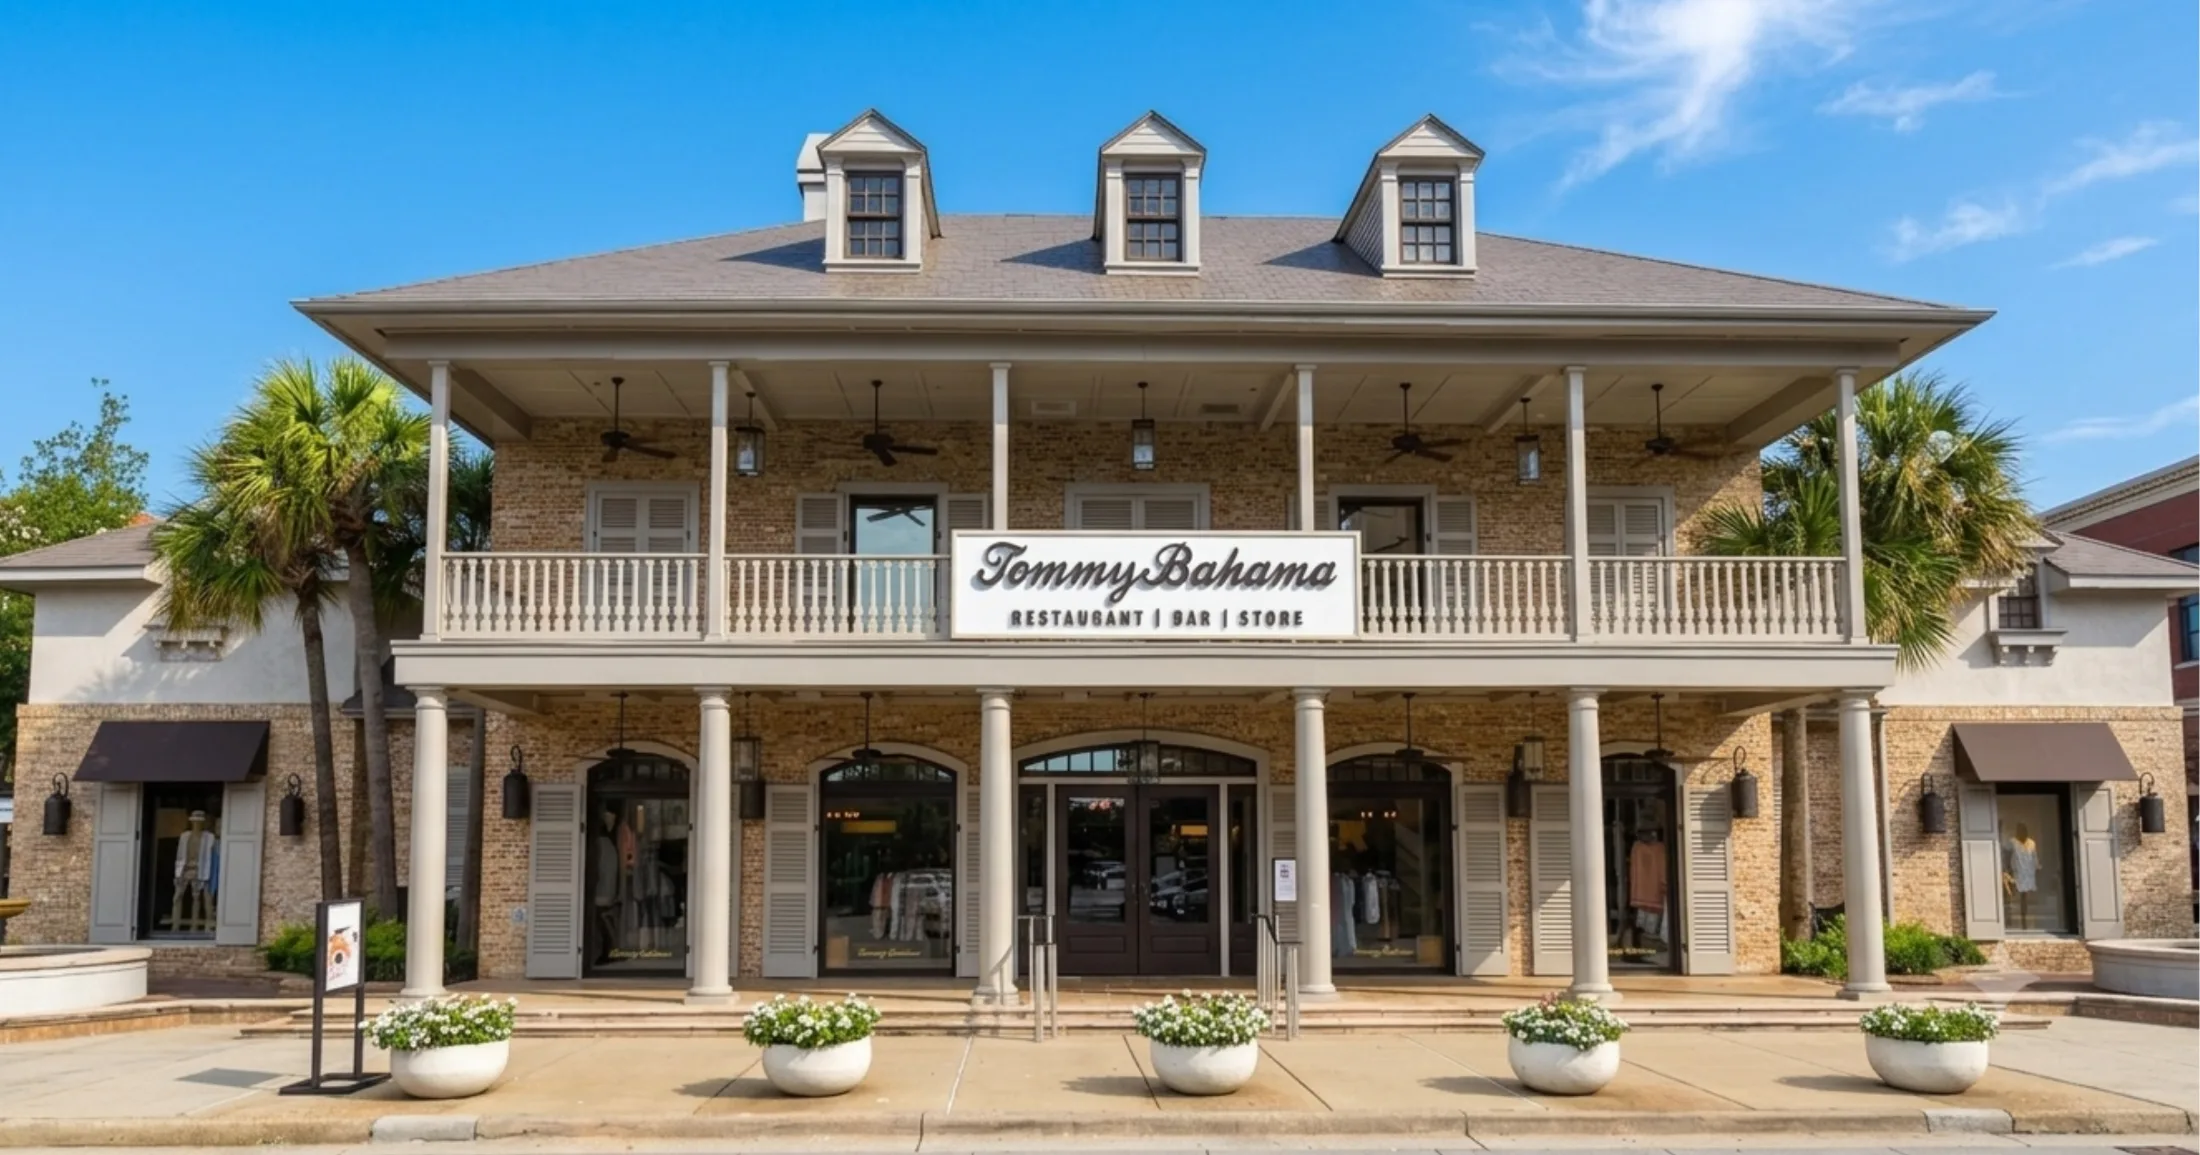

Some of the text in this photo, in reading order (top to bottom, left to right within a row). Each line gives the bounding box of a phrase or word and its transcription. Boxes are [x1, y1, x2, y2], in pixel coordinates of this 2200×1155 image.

[976, 541, 1338, 604] Tommy Bahama
[1172, 609, 1211, 627] BAR
[1238, 609, 1304, 627] STORE
